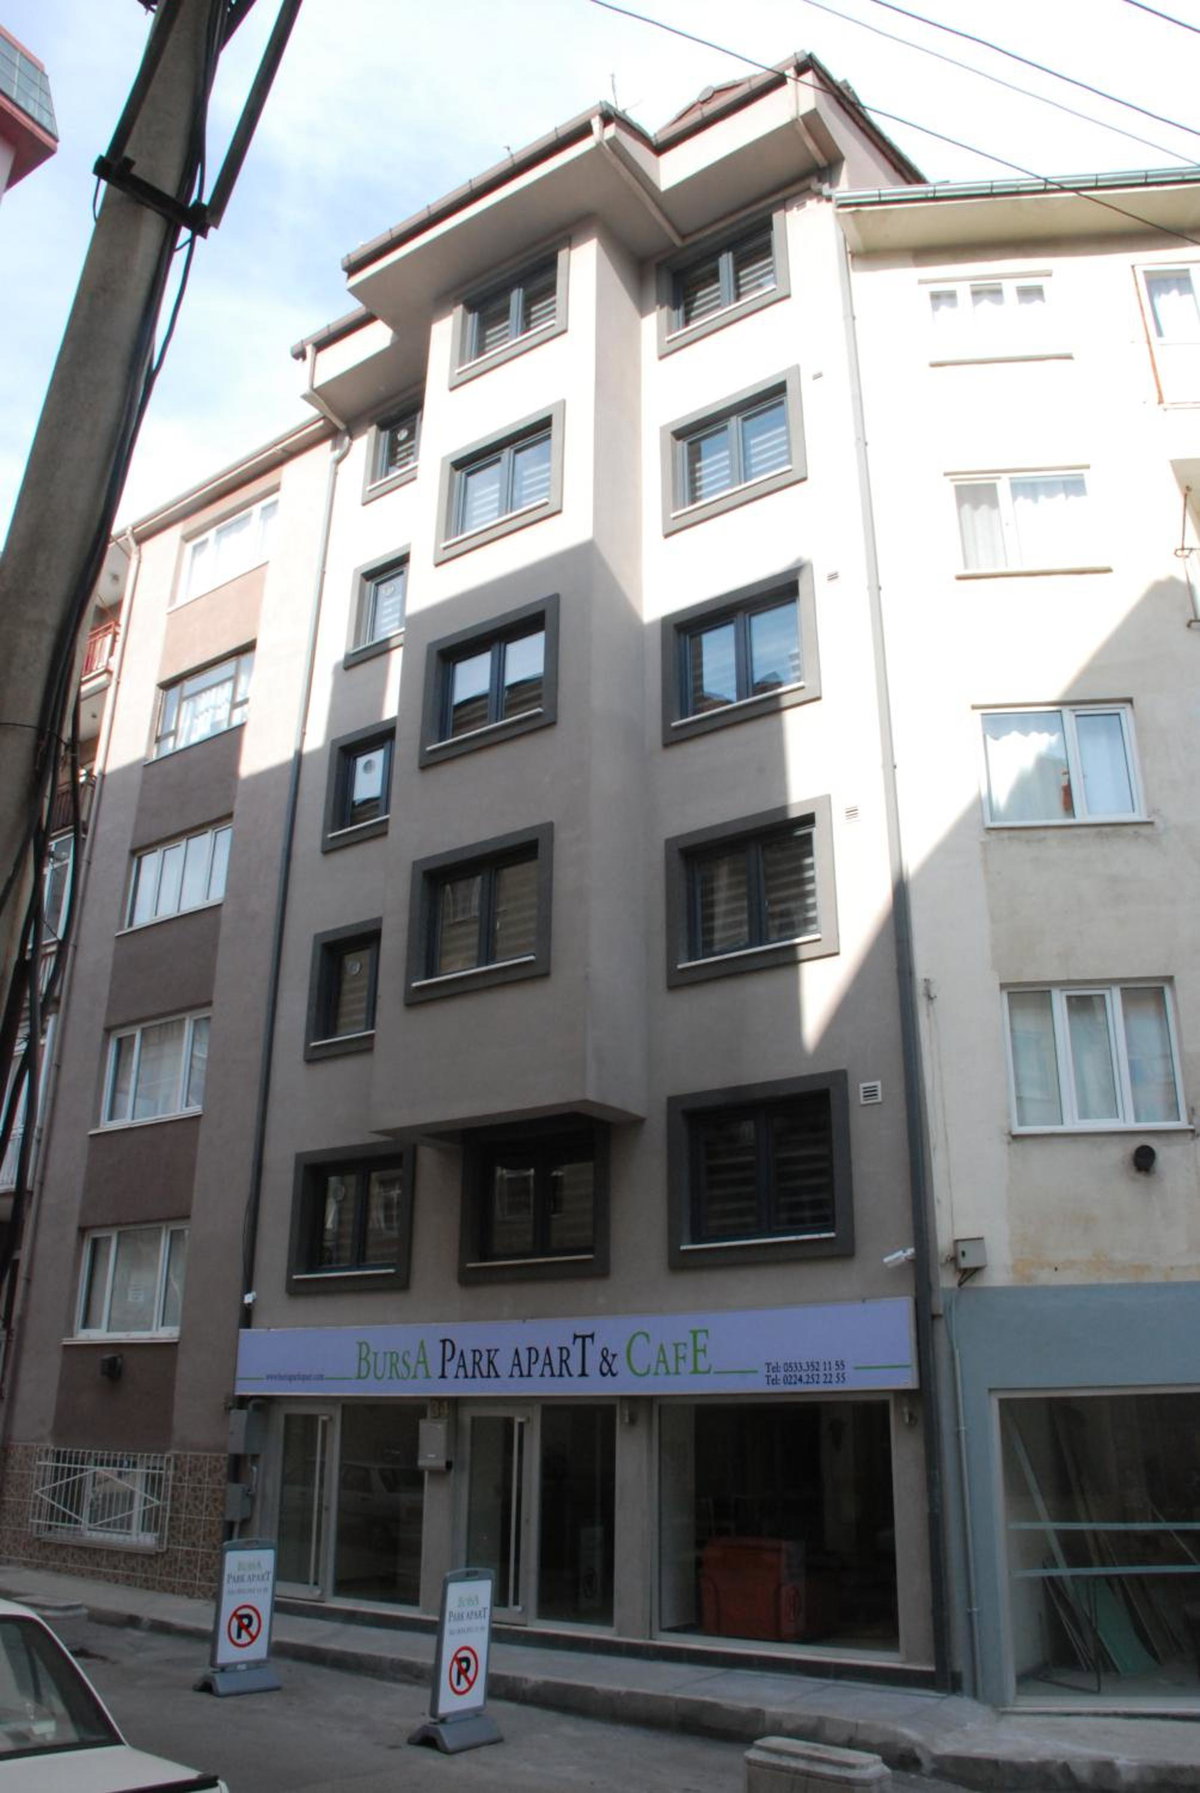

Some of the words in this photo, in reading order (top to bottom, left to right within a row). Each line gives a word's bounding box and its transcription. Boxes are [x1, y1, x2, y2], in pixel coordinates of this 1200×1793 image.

[356, 1338, 430, 1381] BURSA
[438, 1338, 501, 1379] PARK
[508, 1331, 595, 1378] APART
[599, 1346, 619, 1378] &
[626, 1329, 712, 1377] CAFE
[823, 1361, 832, 1371] 11
[835, 1360, 846, 1371] 55
[822, 1373, 833, 1384] 22
[835, 1372, 846, 1384] 55
